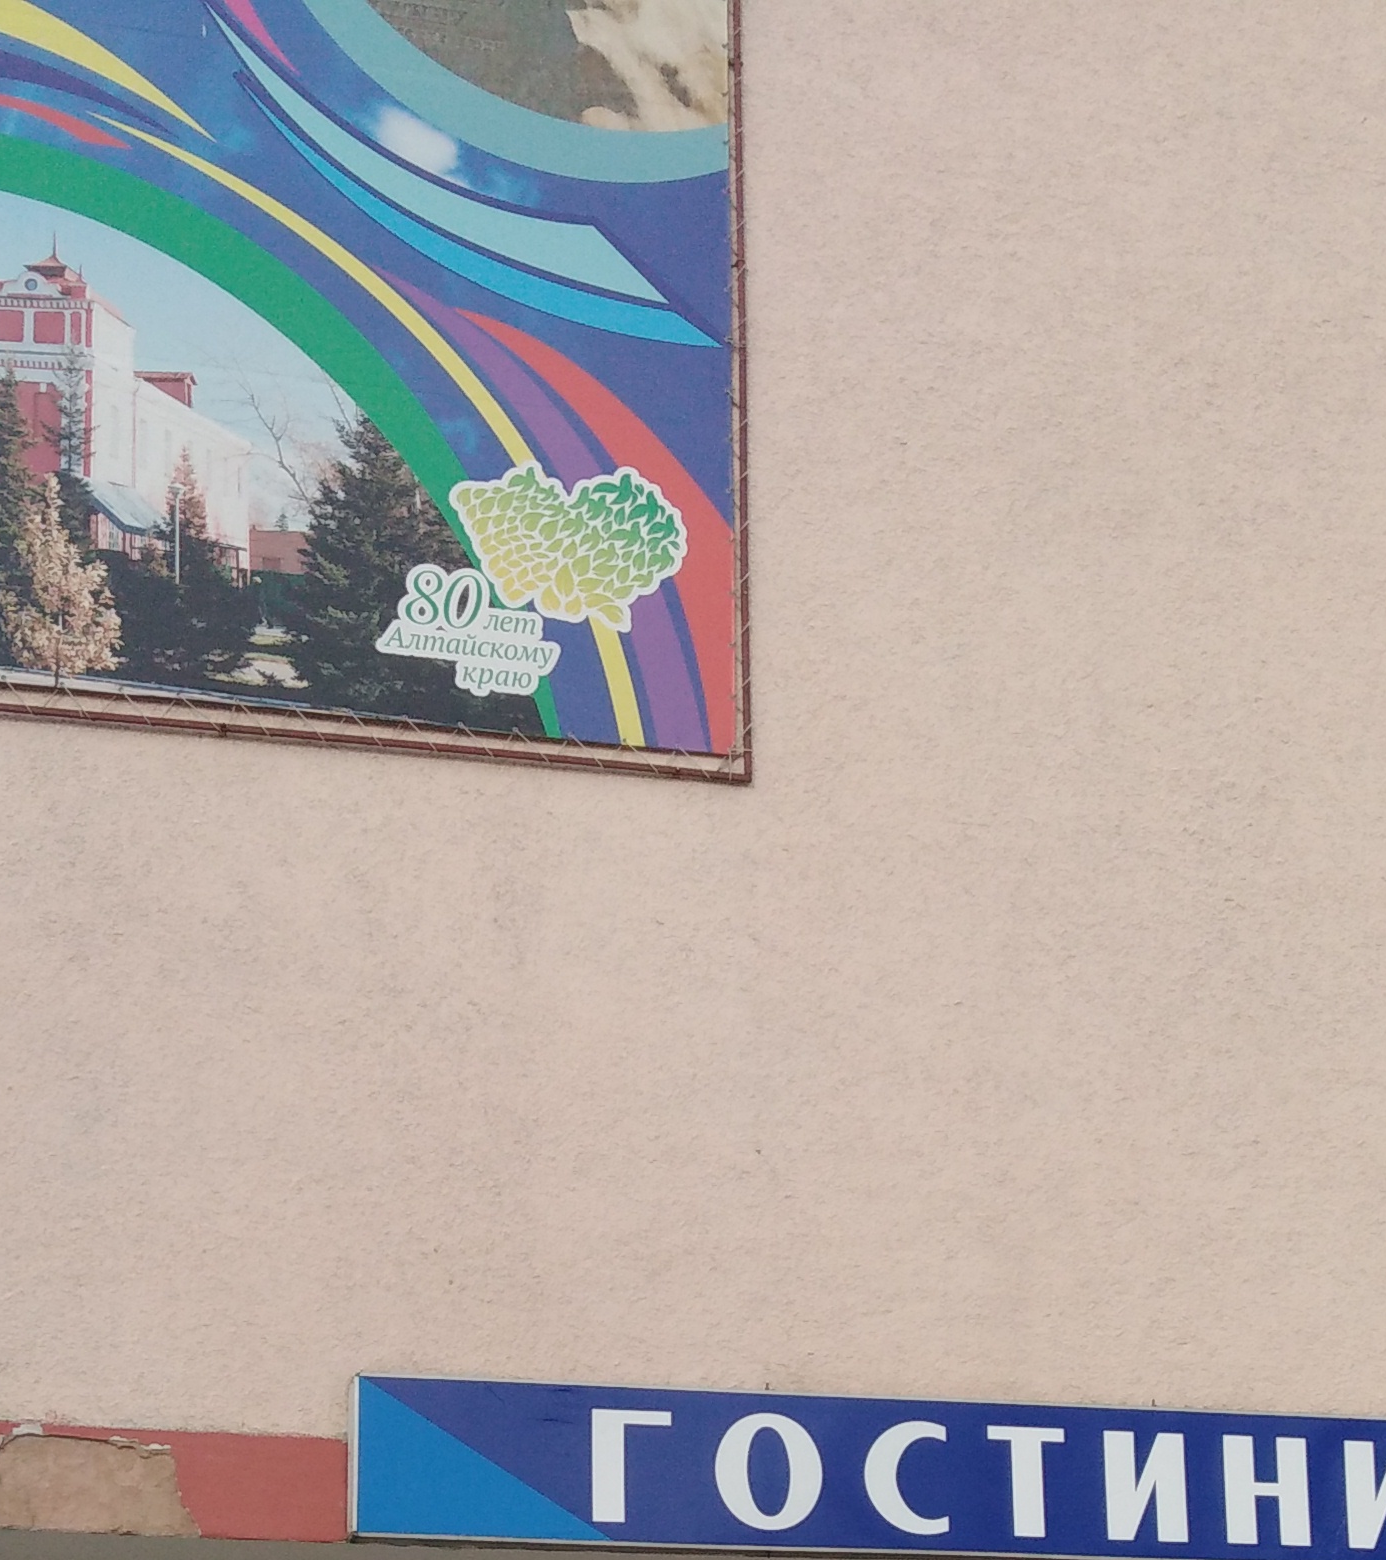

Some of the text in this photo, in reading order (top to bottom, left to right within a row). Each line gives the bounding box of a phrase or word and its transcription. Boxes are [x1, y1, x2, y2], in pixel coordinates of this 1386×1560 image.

[405, 571, 536, 635] 80 лет
[384, 626, 555, 668] Алтайскому
[461, 666, 533, 690] краю
